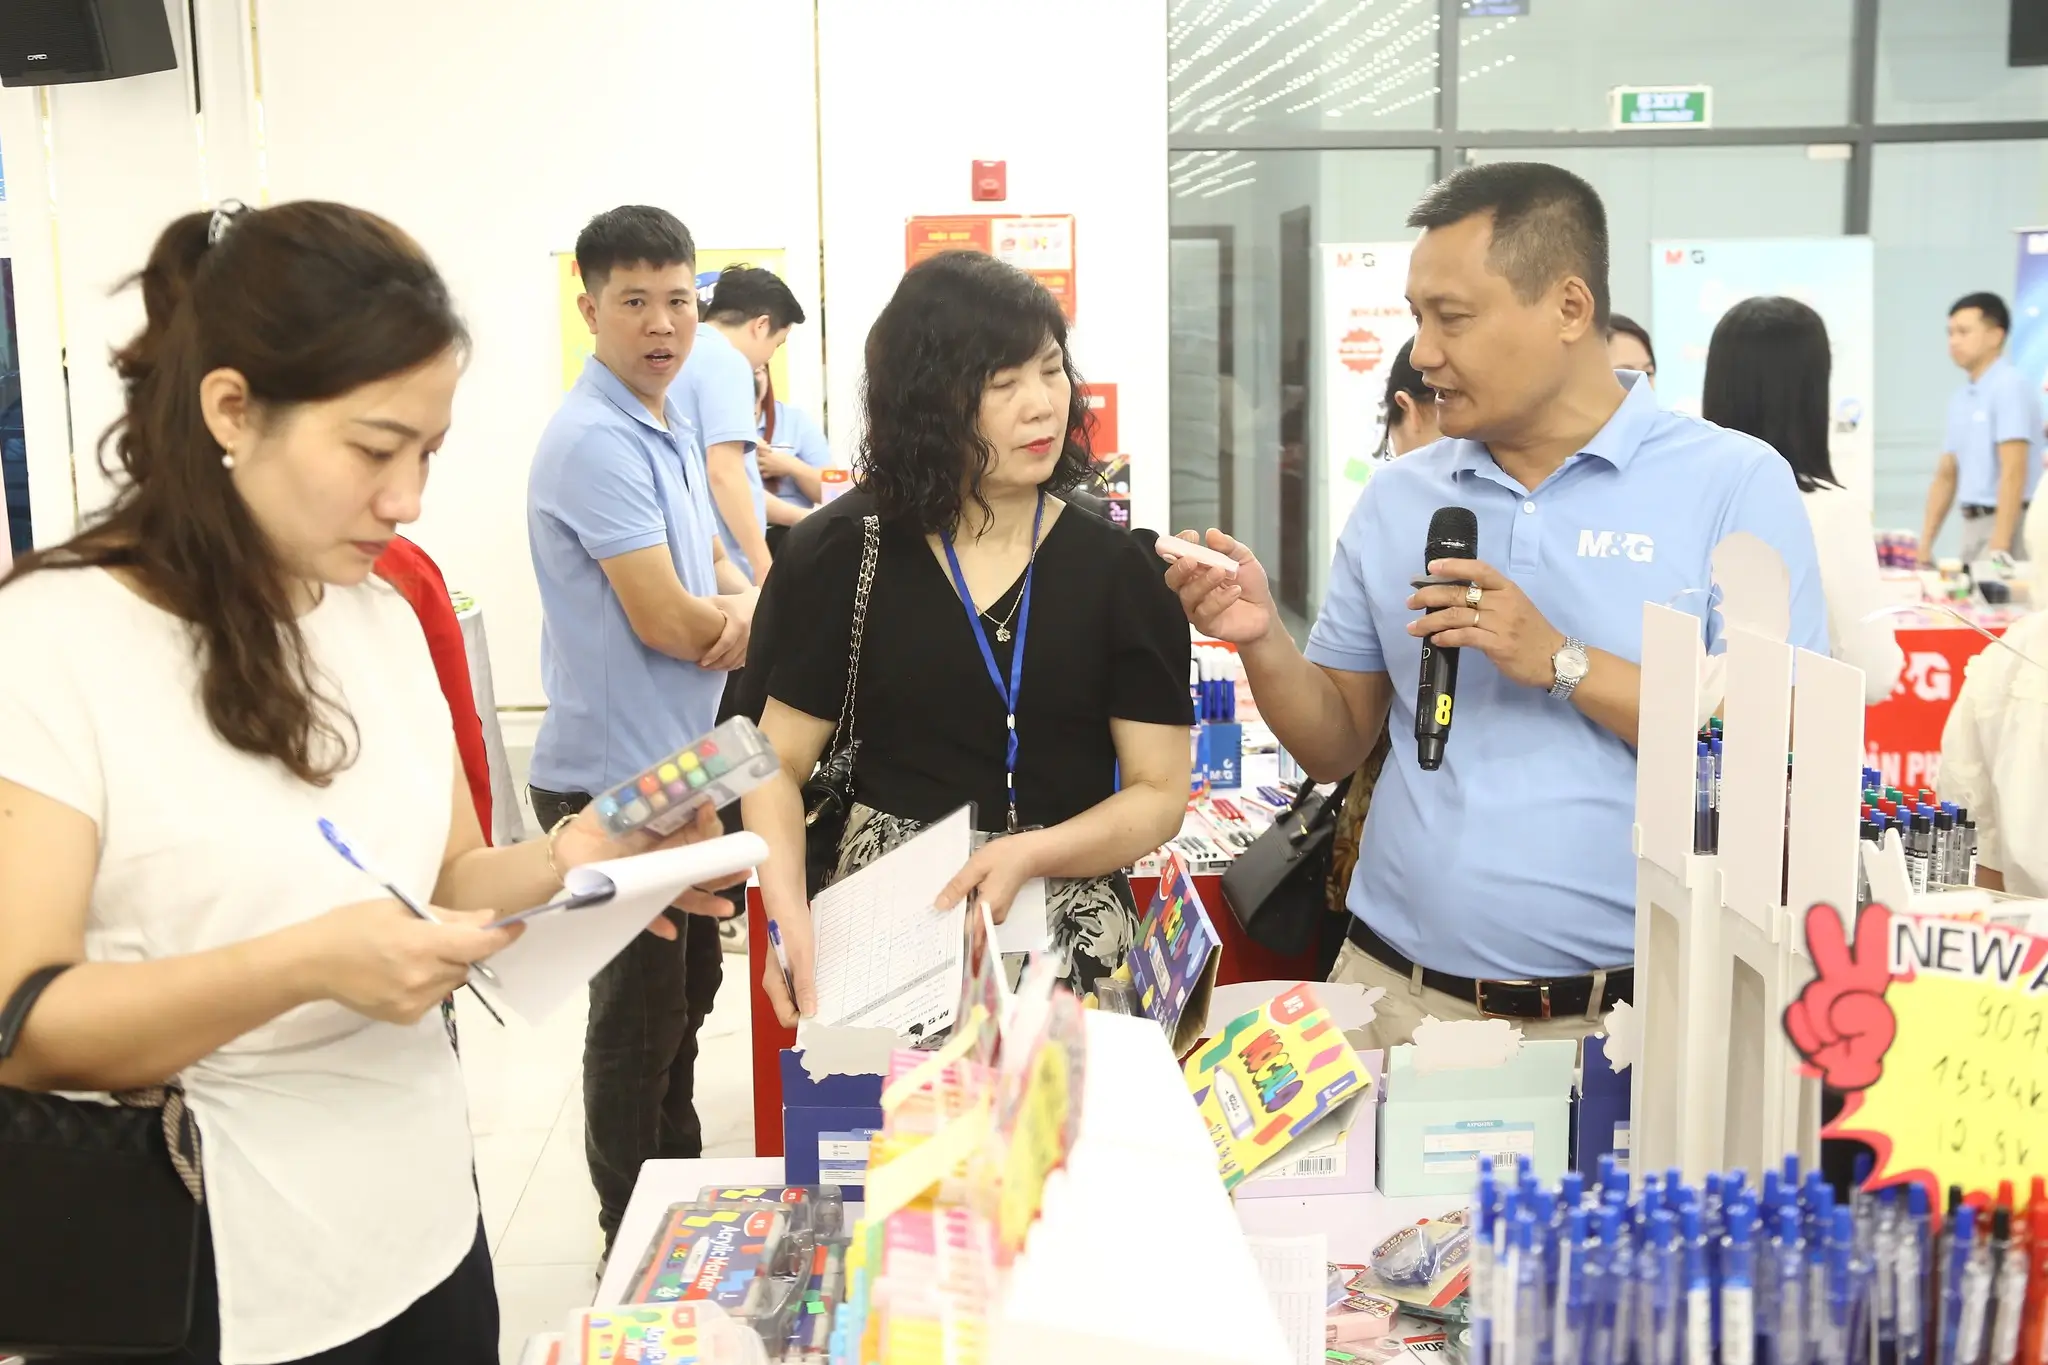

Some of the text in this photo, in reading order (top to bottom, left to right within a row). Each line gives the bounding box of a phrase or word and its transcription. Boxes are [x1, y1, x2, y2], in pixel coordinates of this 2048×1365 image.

[1636, 92, 1691, 109] EXIT
[1577, 529, 1655, 563] M&G
[1434, 693, 1453, 727] 8
[1895, 922, 2023, 982] NEW
[1237, 1028, 1304, 1114] MOCALO
[697, 1224, 741, 1292] Acrylic Marker
